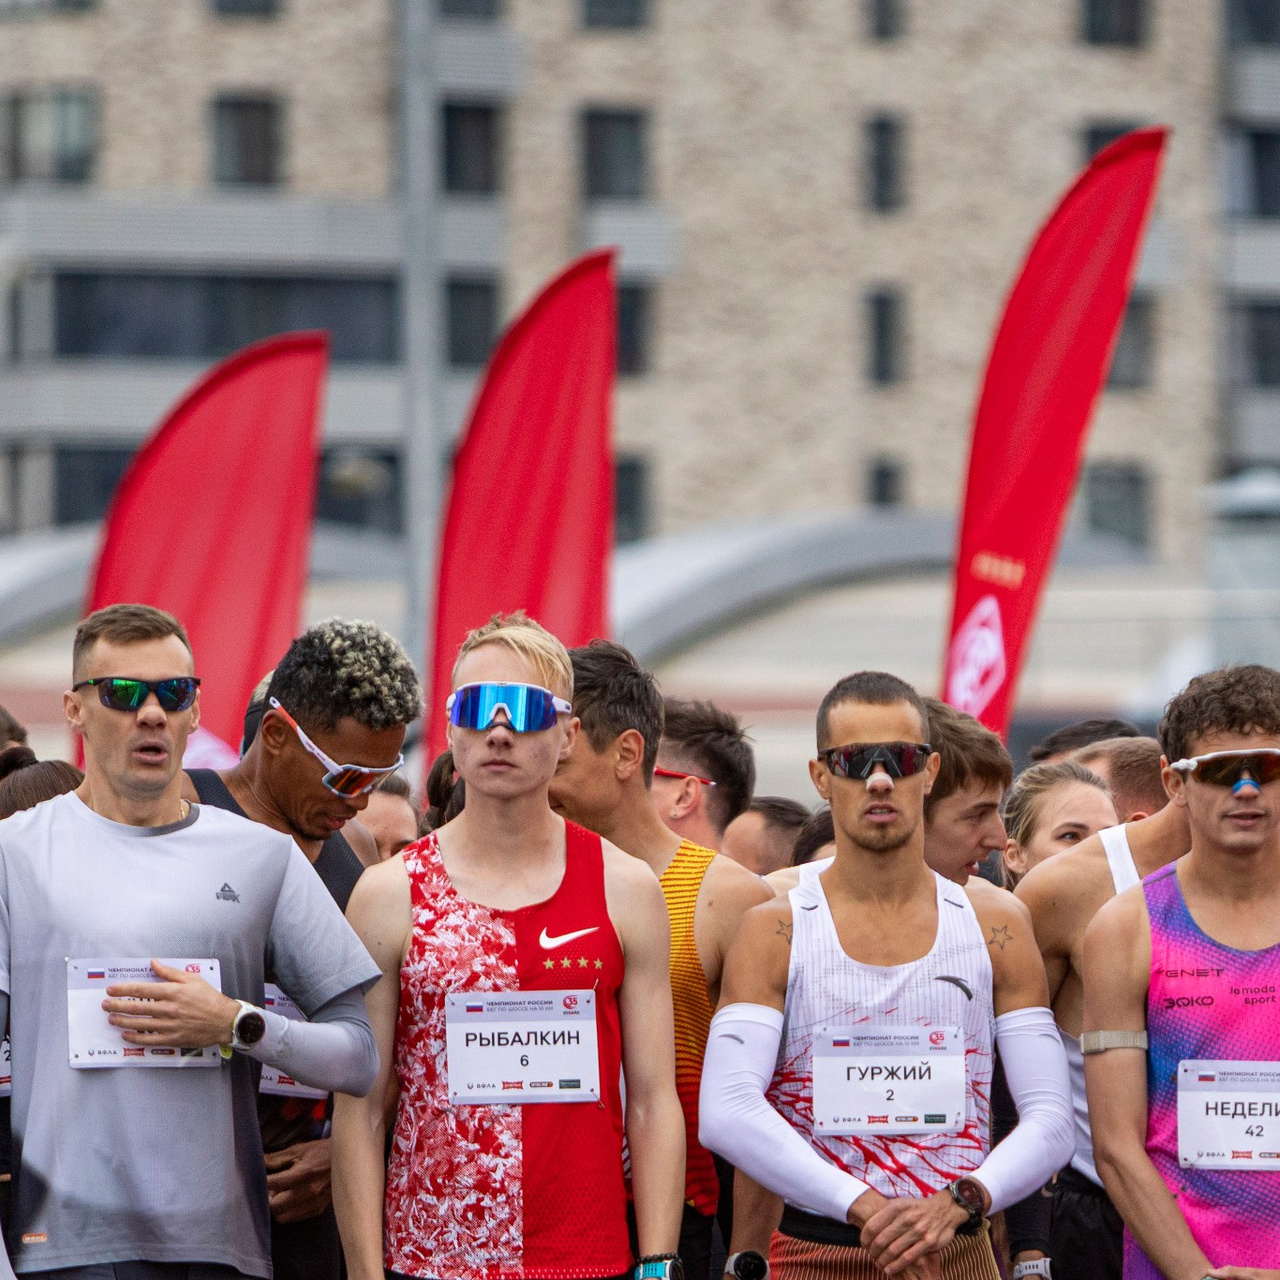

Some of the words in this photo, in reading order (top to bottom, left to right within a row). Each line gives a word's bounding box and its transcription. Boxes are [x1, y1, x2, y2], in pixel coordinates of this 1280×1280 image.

[568, 997, 577, 1005] 35
[465, 1031, 580, 1047] РЫБАЛКИН
[520, 1054, 529, 1066] 6
[846, 1061, 931, 1080] ГУРЖИЙ
[886, 1089, 894, 1100] 2
[1245, 1125, 1264, 1137] 42
